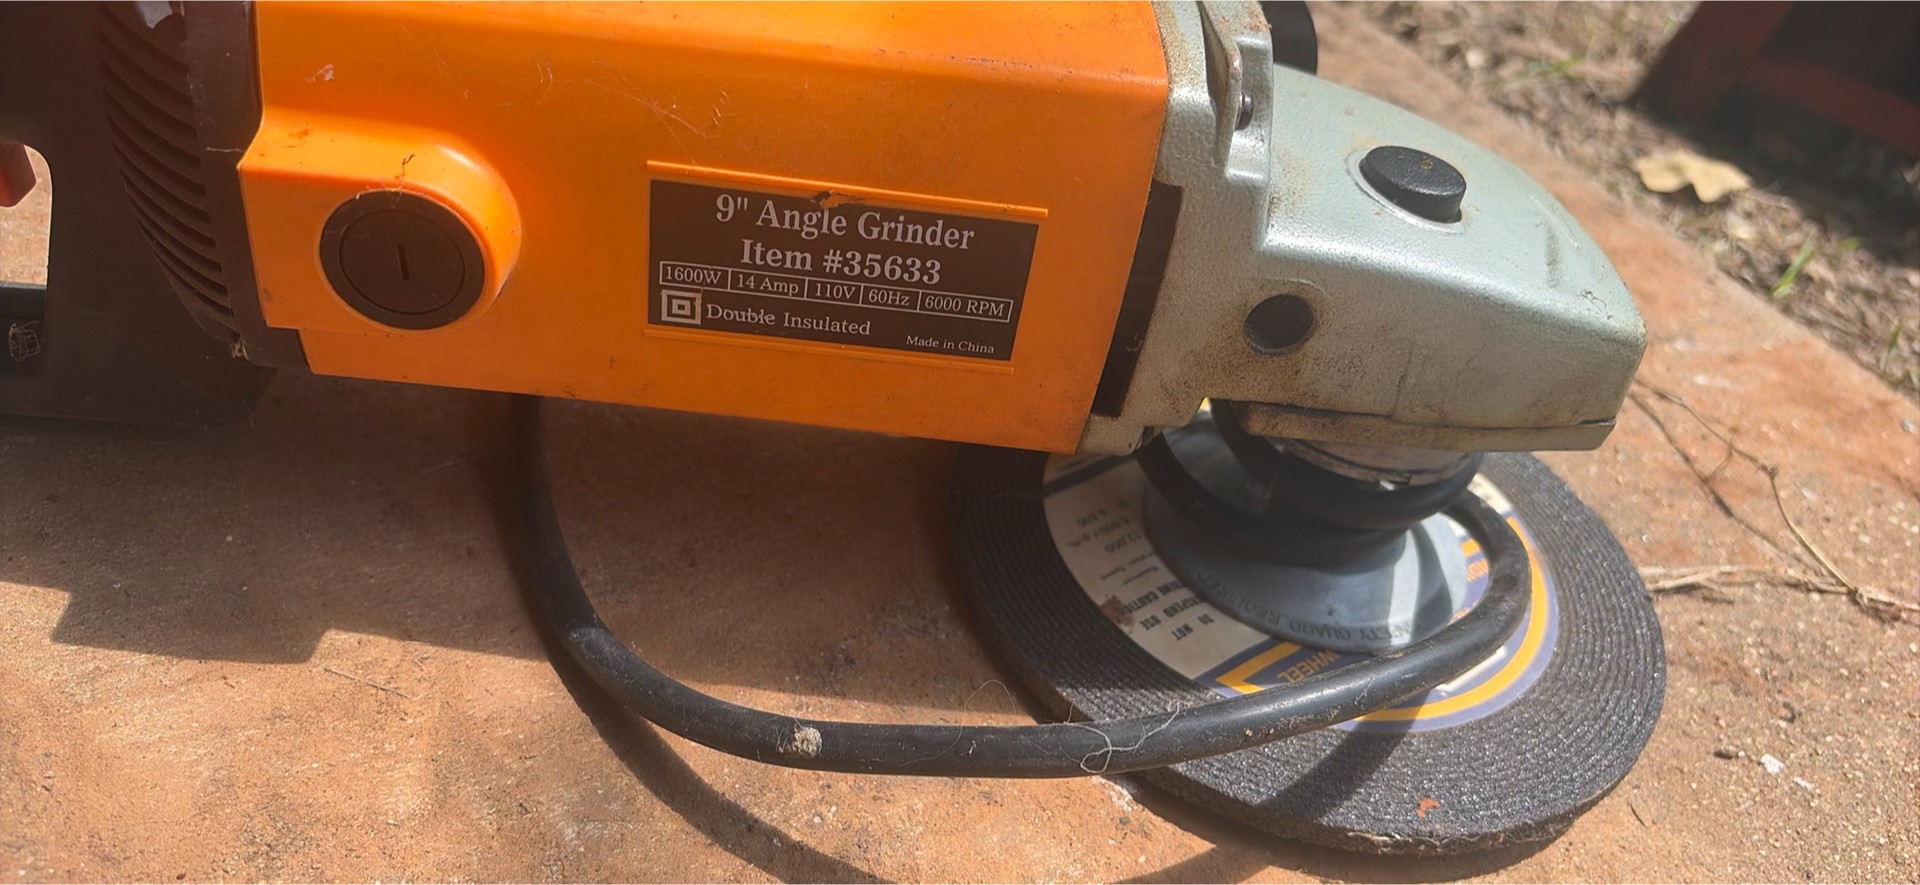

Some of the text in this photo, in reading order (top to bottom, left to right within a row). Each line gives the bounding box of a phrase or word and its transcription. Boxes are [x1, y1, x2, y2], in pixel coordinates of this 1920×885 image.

[716, 193, 975, 250] 9" Angle Grinder
[740, 238, 942, 285] Item #35633
[666, 265, 722, 285] 1600W
[737, 274, 799, 295] 14 Amp
[815, 282, 857, 299] 110V
[868, 288, 910, 306] 60Hz
[924, 295, 1006, 317] 6000 RPM
[706, 303, 871, 335] Double Insulated
[905, 334, 995, 354] Made in China
[1360, 620, 1414, 641] AFETY
[1277, 650, 1341, 685] WHEEL
